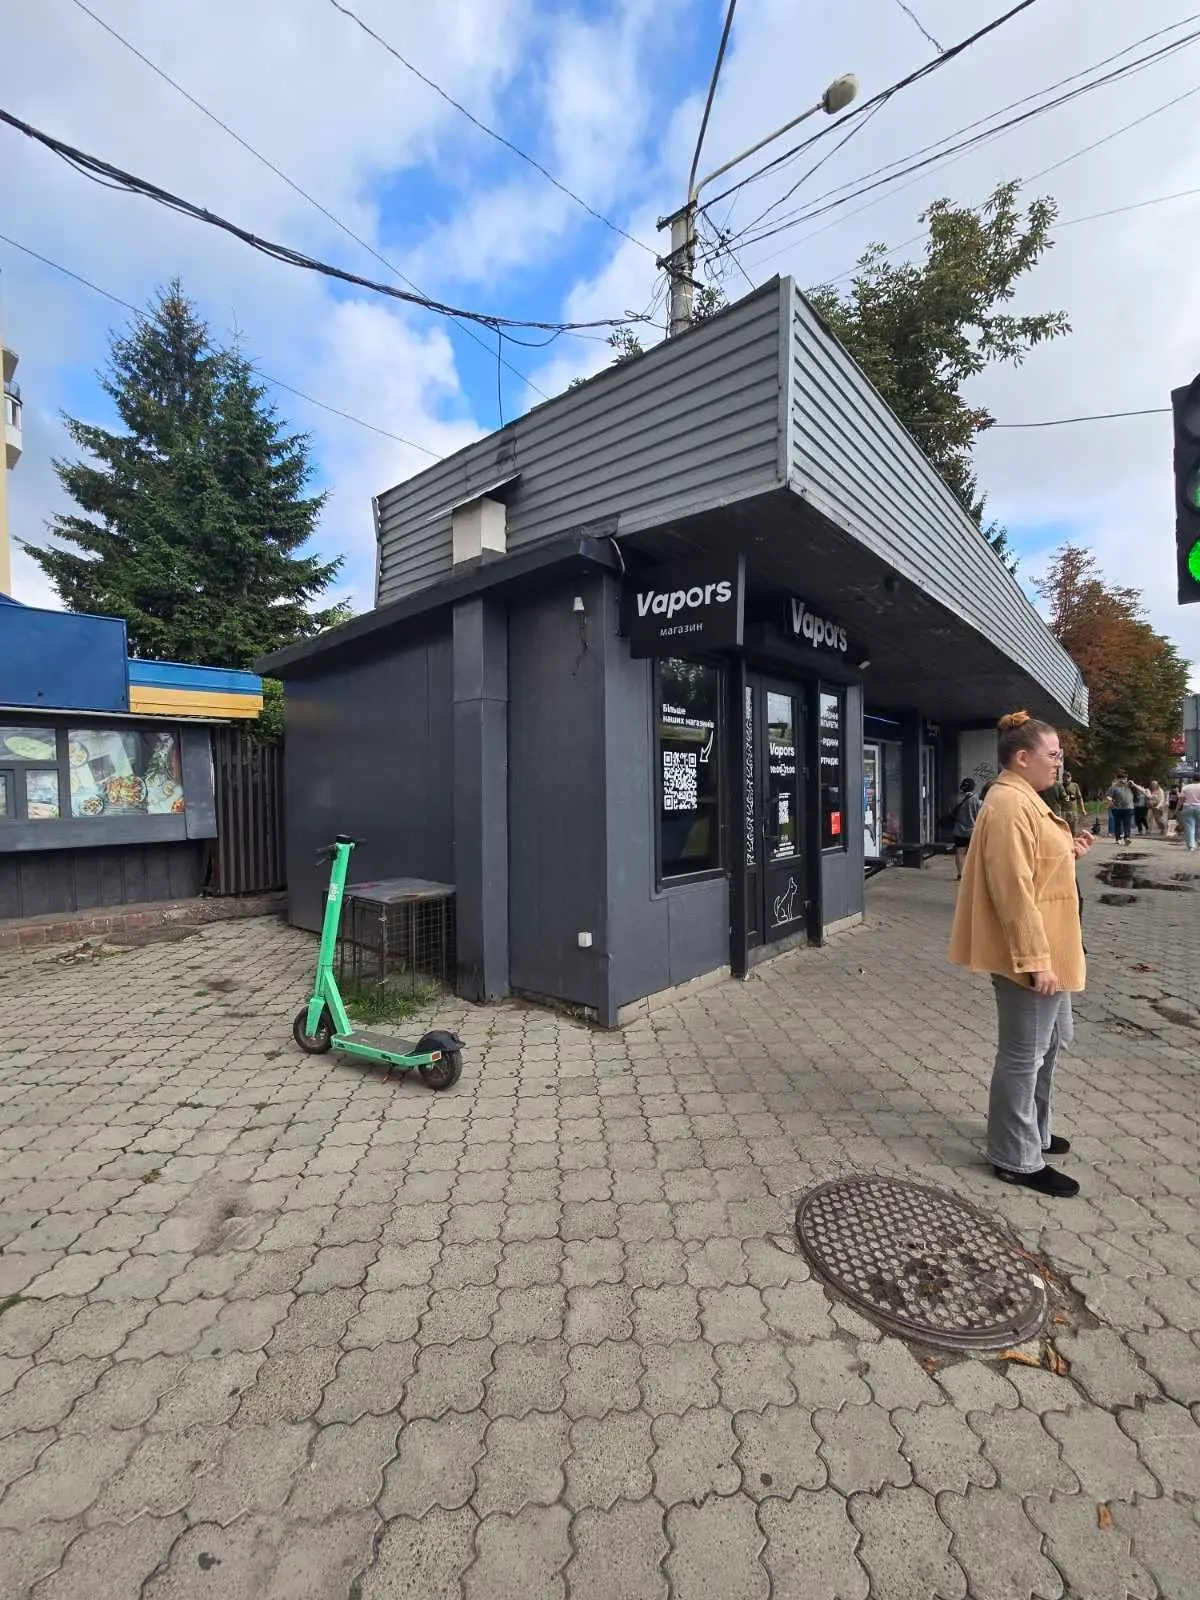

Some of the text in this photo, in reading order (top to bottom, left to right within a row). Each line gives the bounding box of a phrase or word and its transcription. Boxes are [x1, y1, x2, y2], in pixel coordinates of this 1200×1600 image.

[637, 581, 732, 618] Vapors
[660, 622, 704, 637] магазин
[791, 598, 847, 652] Vapors
[663, 715, 685, 725] наших
[769, 742, 795, 758] Vapors
